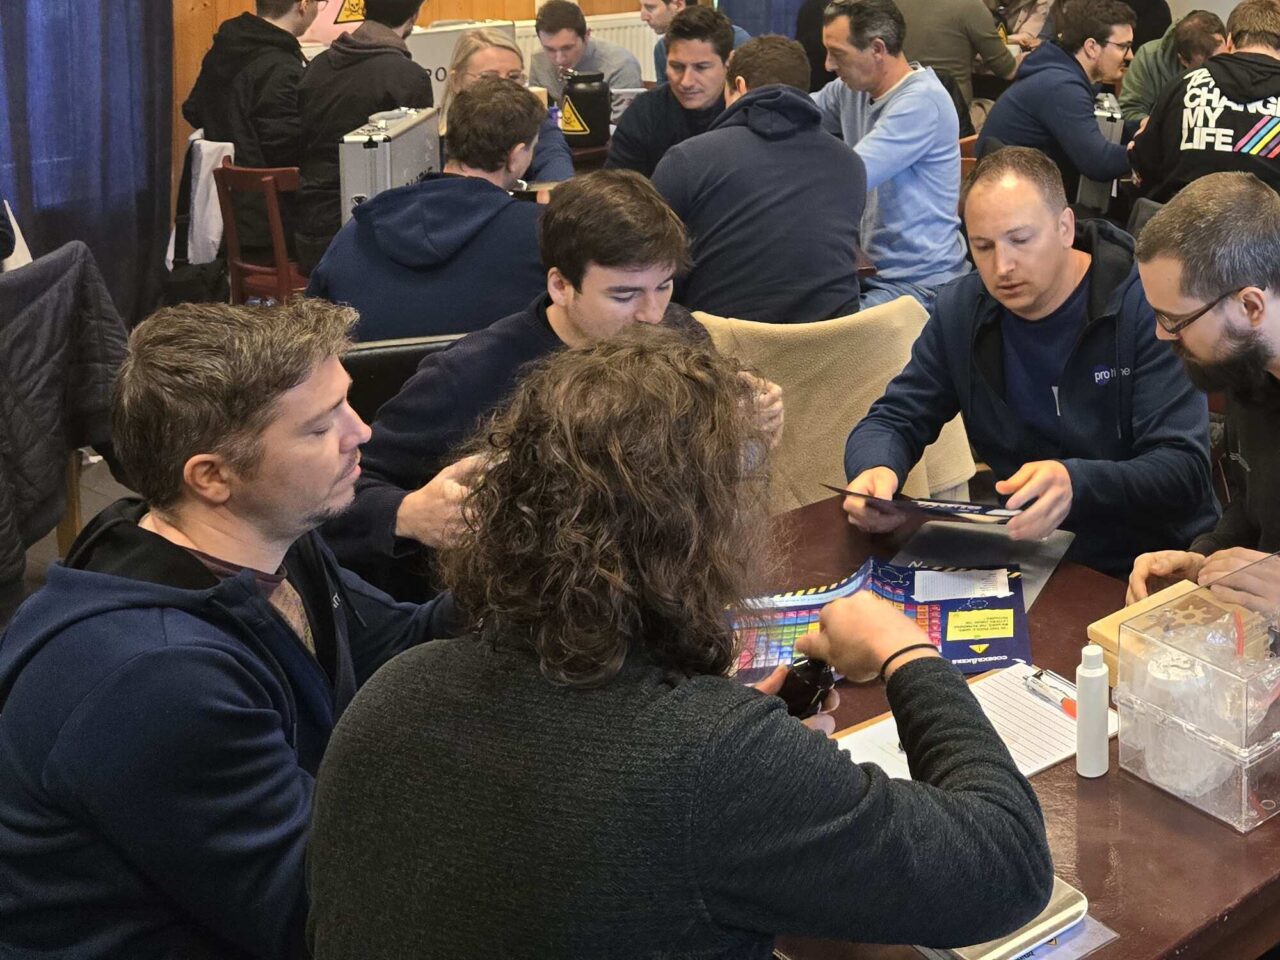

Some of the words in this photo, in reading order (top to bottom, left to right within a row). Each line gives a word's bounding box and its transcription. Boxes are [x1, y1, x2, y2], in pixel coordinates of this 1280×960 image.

[1183, 106, 1224, 128] MY
[1180, 126, 1234, 152] LIFE
[1094, 367, 1131, 383] protie
